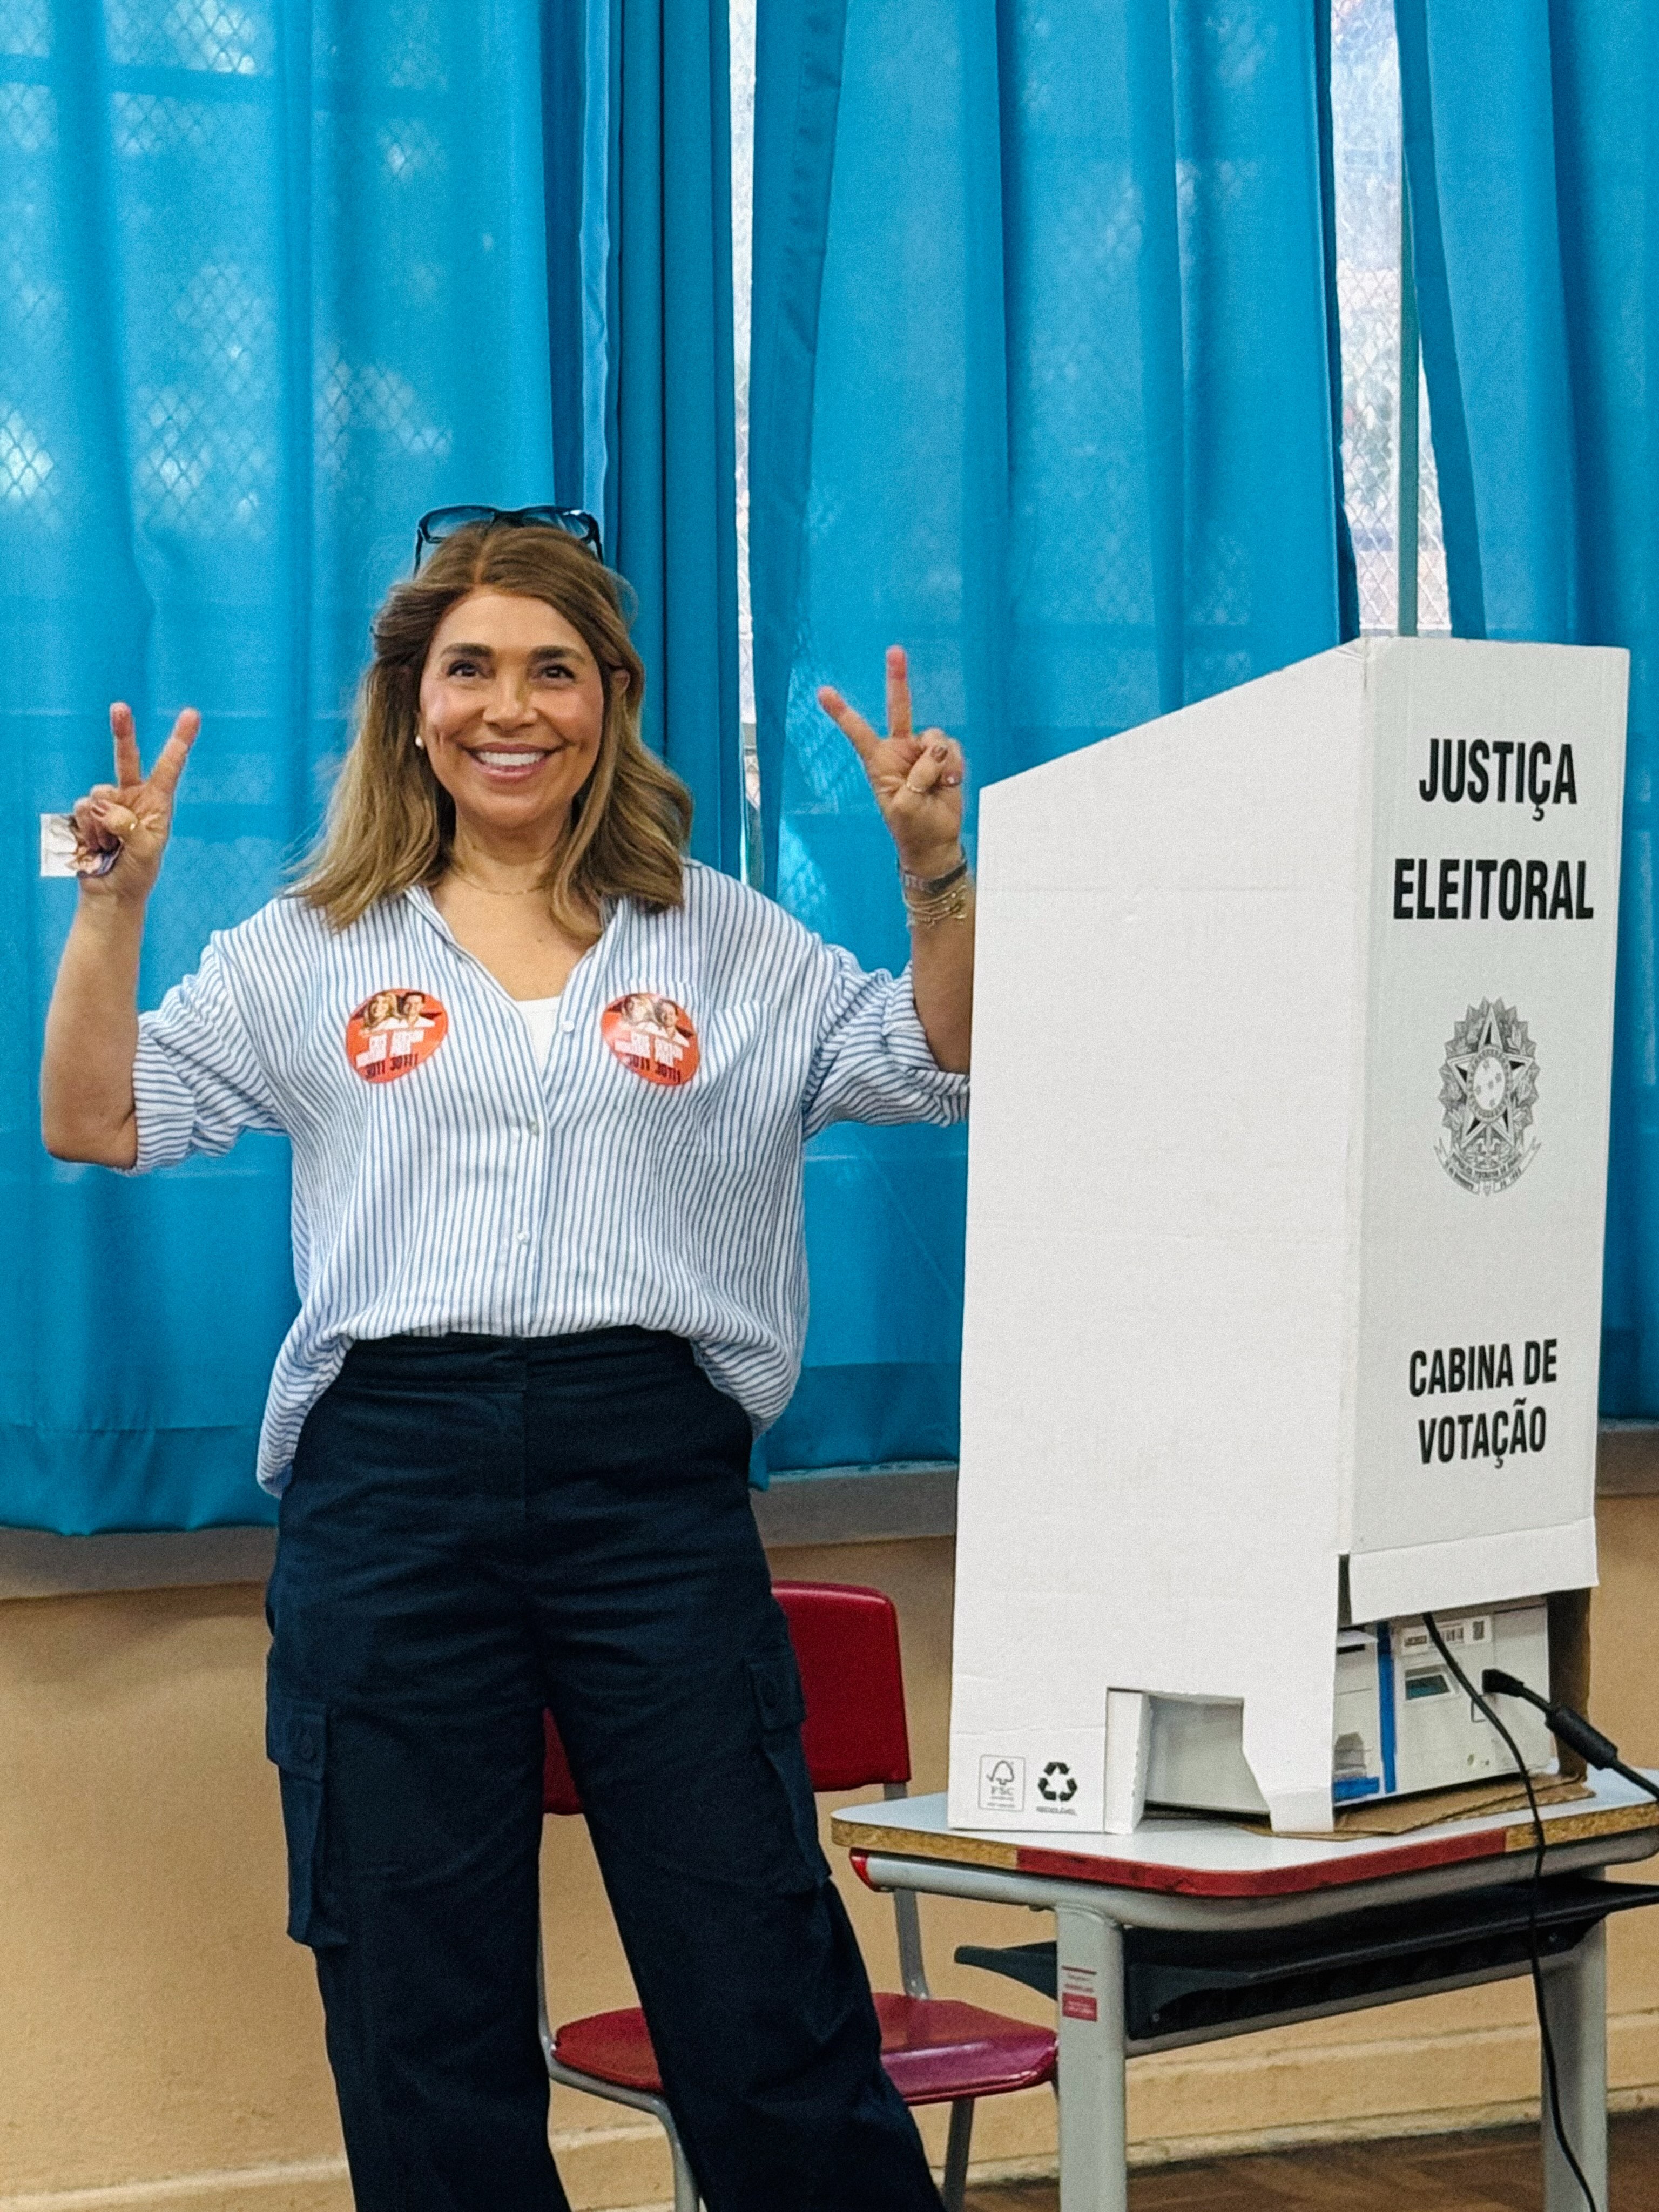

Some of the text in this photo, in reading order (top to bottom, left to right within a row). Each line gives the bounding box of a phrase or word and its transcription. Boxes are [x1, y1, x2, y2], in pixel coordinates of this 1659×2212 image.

[1419, 738, 1577, 822] JUSTIÇA
[1393, 858, 1594, 921] ELEITORAL
[1408, 1338, 1557, 1397] CABINA DE
[1418, 1397, 1547, 1469] VOTAÇÃO
